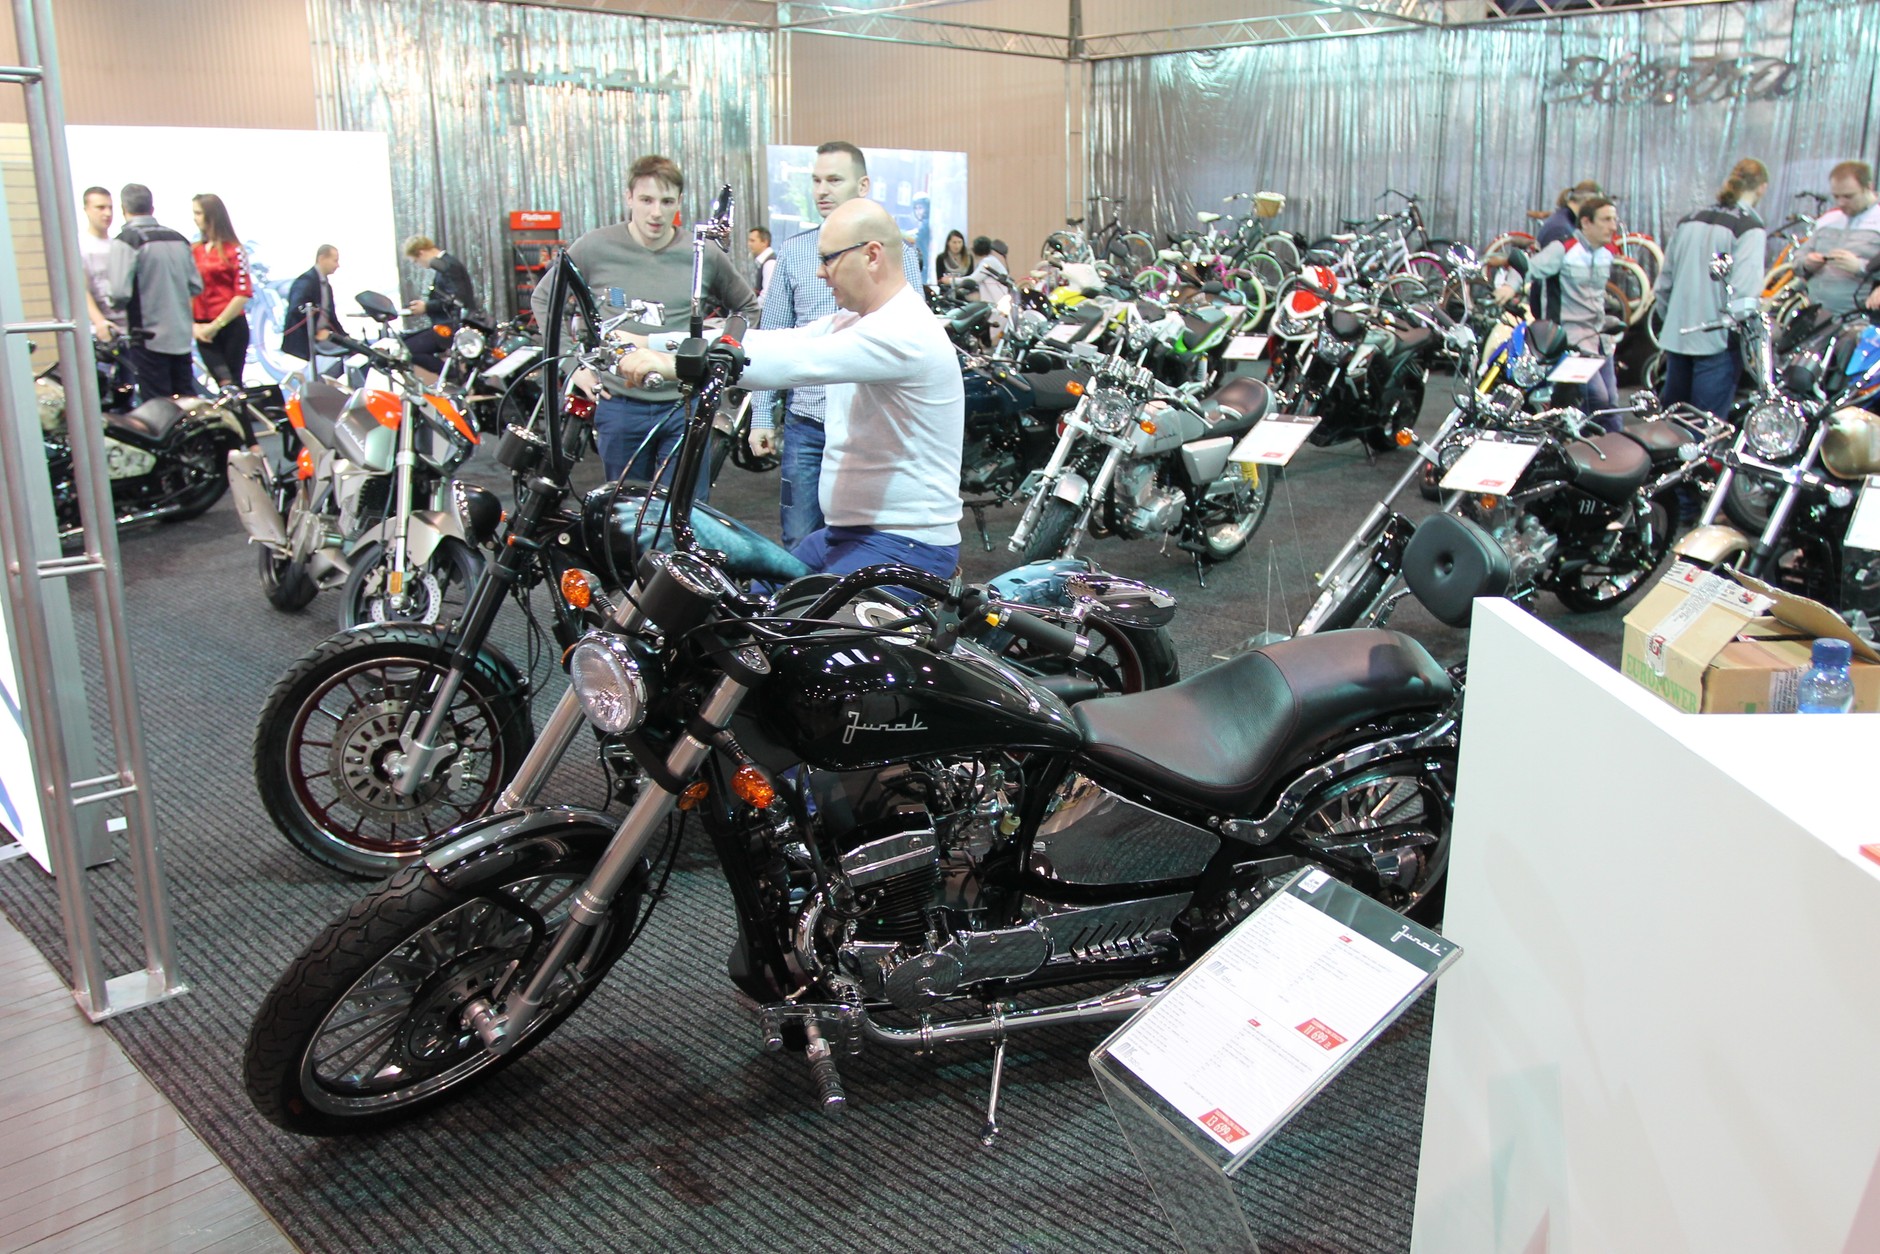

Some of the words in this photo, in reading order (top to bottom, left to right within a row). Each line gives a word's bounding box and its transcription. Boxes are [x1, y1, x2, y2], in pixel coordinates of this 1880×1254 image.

[842, 710, 928, 744] Junak
[1390, 924, 1442, 957] Junak
[1213, 1122, 1232, 1137] 699
